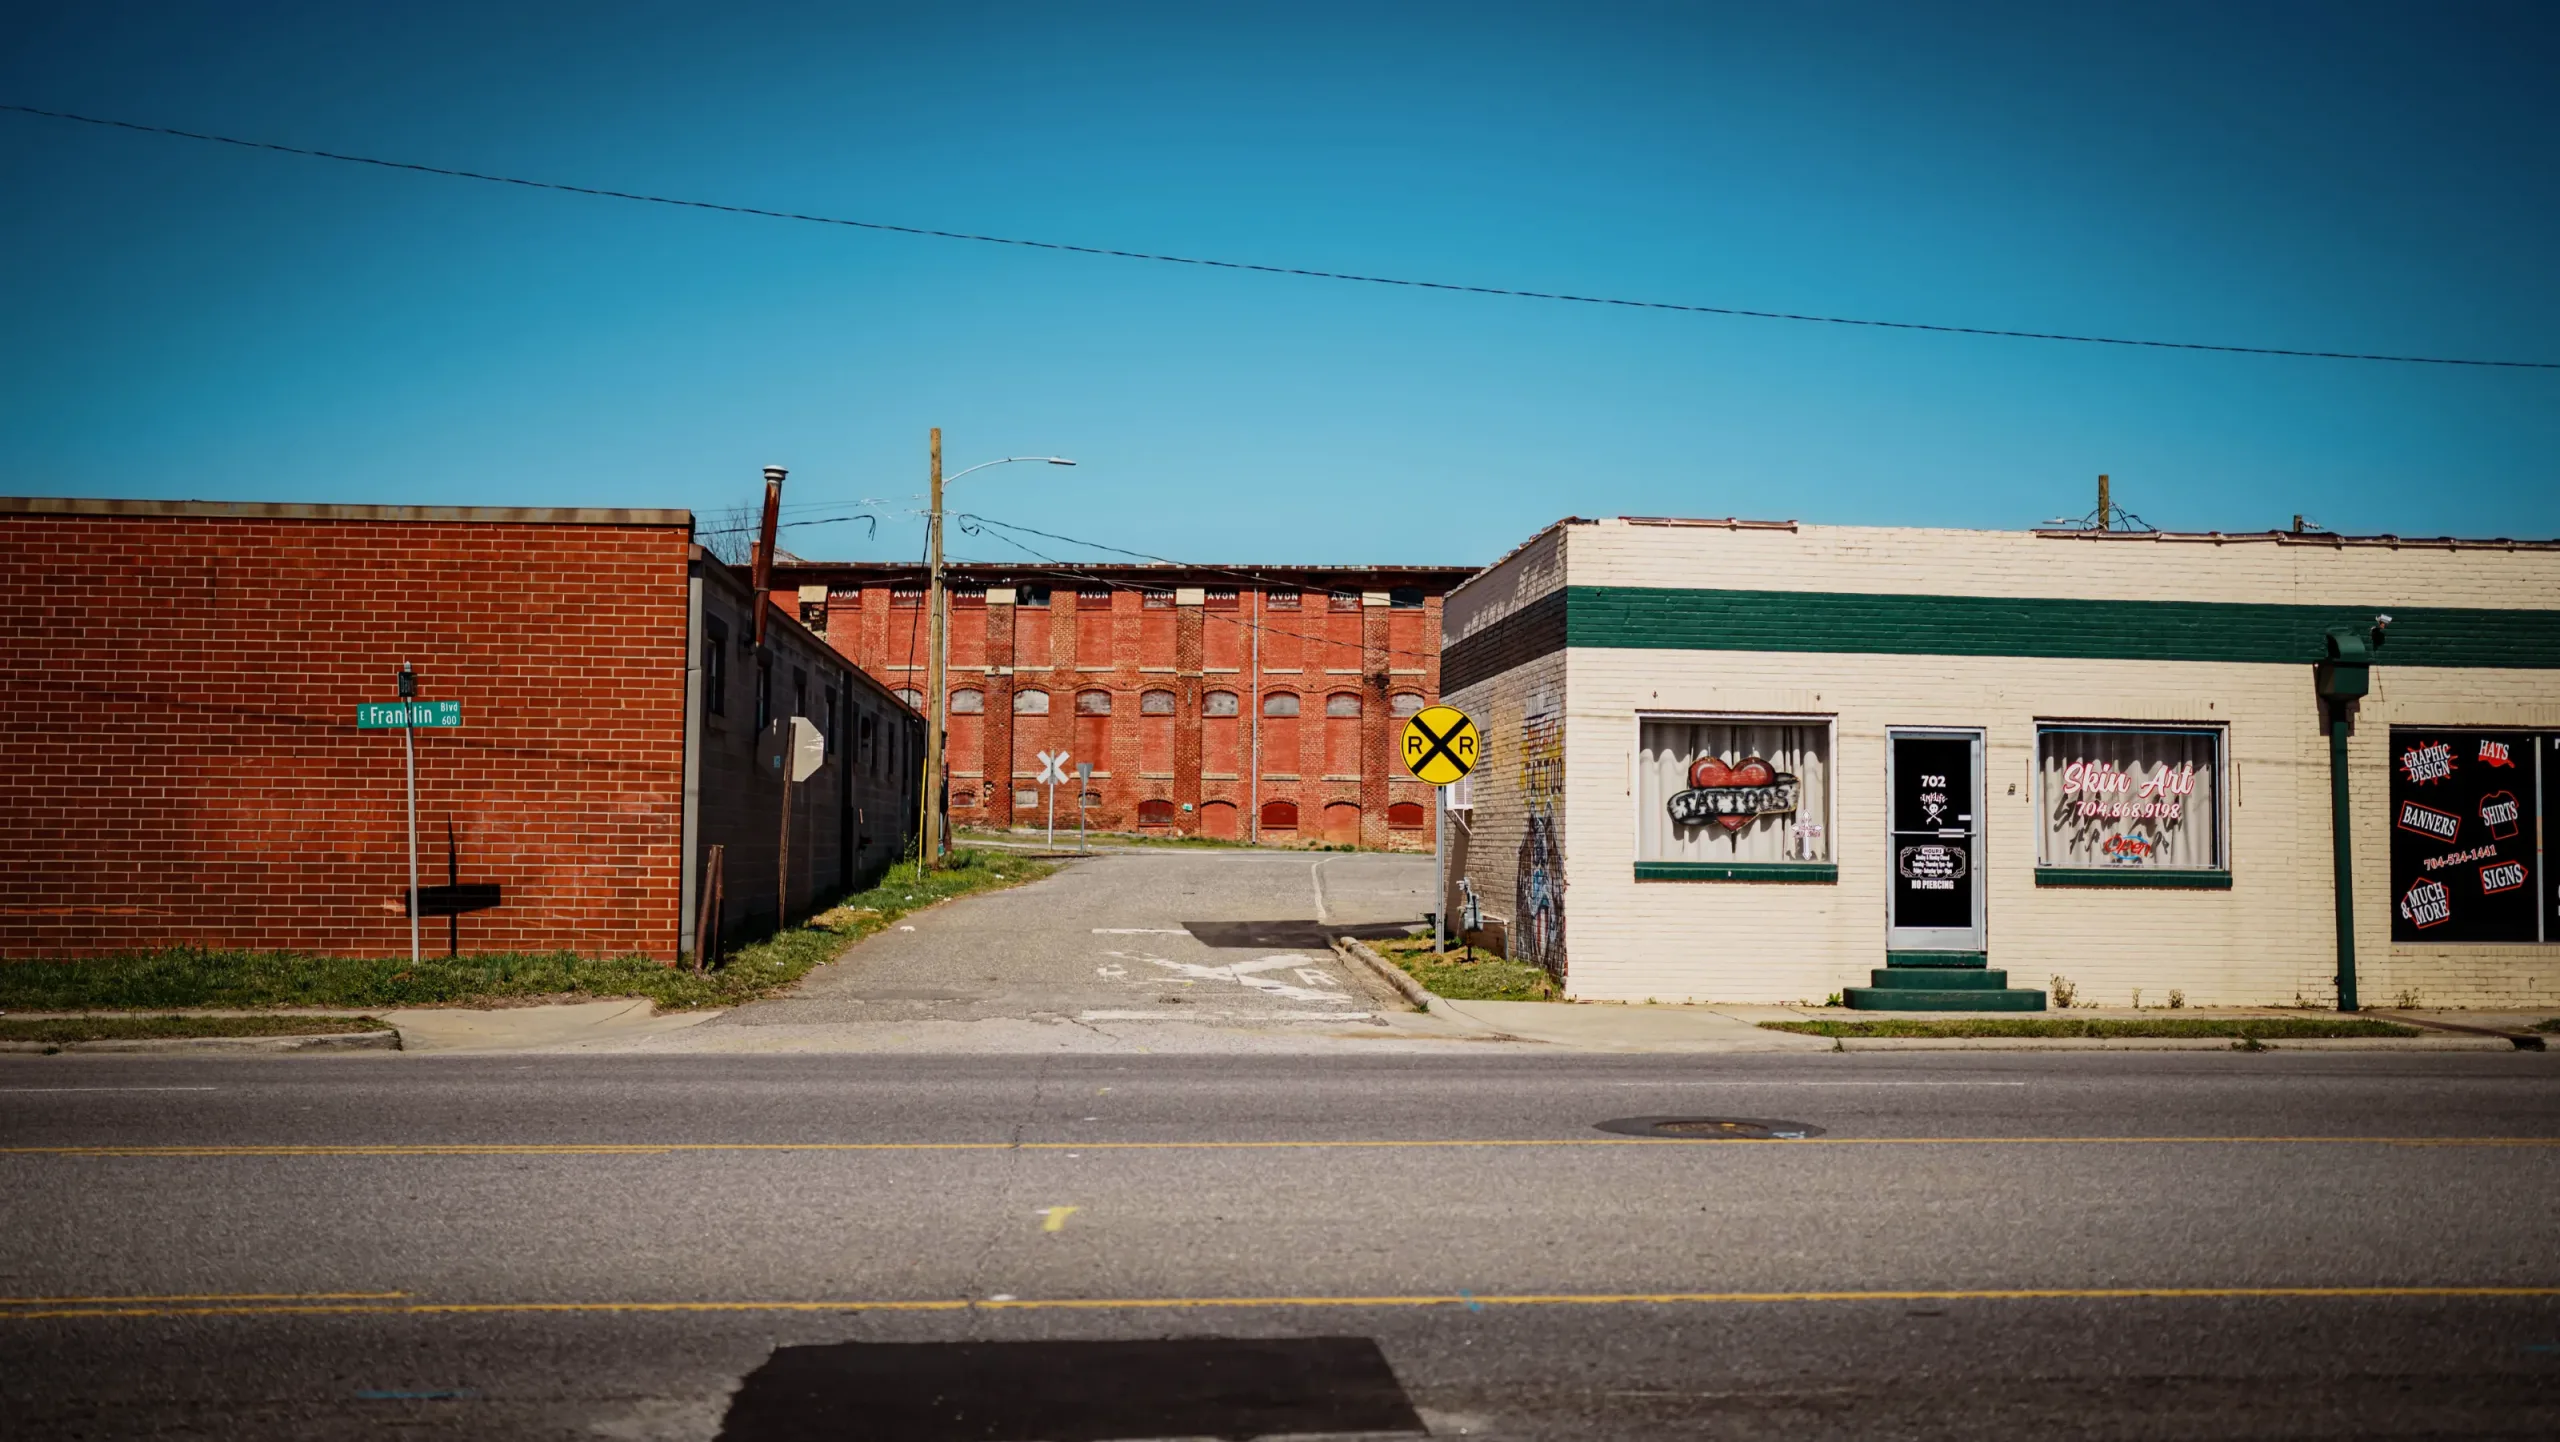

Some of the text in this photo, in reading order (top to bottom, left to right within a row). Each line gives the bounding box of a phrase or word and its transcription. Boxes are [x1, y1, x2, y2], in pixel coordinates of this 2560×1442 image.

[830, 589, 859, 599] AVON
[893, 589, 922, 599] AVON
[956, 589, 985, 599] AVON
[1080, 590, 1109, 600] AVON
[1145, 591, 1174, 600] AVON
[1207, 591, 1236, 601] AVON
[1270, 592, 1299, 602] AVON
[1331, 592, 1360, 602] AVON
[360, 705, 432, 725] E Franklin
[440, 702, 458, 713] Blvd
[441, 715, 457, 726] 600
[1408, 736, 1474, 754] R R
[2478, 739, 2509, 760] HATS
[2403, 743, 2451, 768] GRAPHIC
[1525, 757, 1564, 797] TATTOO
[1921, 774, 1946, 788] 702
[2063, 761, 2194, 798] Skin Art
[2410, 760, 2451, 783] DESIGN
[1676, 788, 1789, 817] TATTOOS
[2077, 801, 2181, 819] 704.868.9198
[2402, 806, 2457, 837] BANNERS
[2482, 801, 2518, 827] SHIRTS
[2104, 833, 2151, 857] Open
[2424, 844, 2497, 871] 704-524-1441
[1911, 880, 1954, 890] NO PIERCING
[2483, 864, 2523, 890] SIGNS
[2401, 882, 2446, 919] & MUCH
[2413, 900, 2450, 925] MORE
